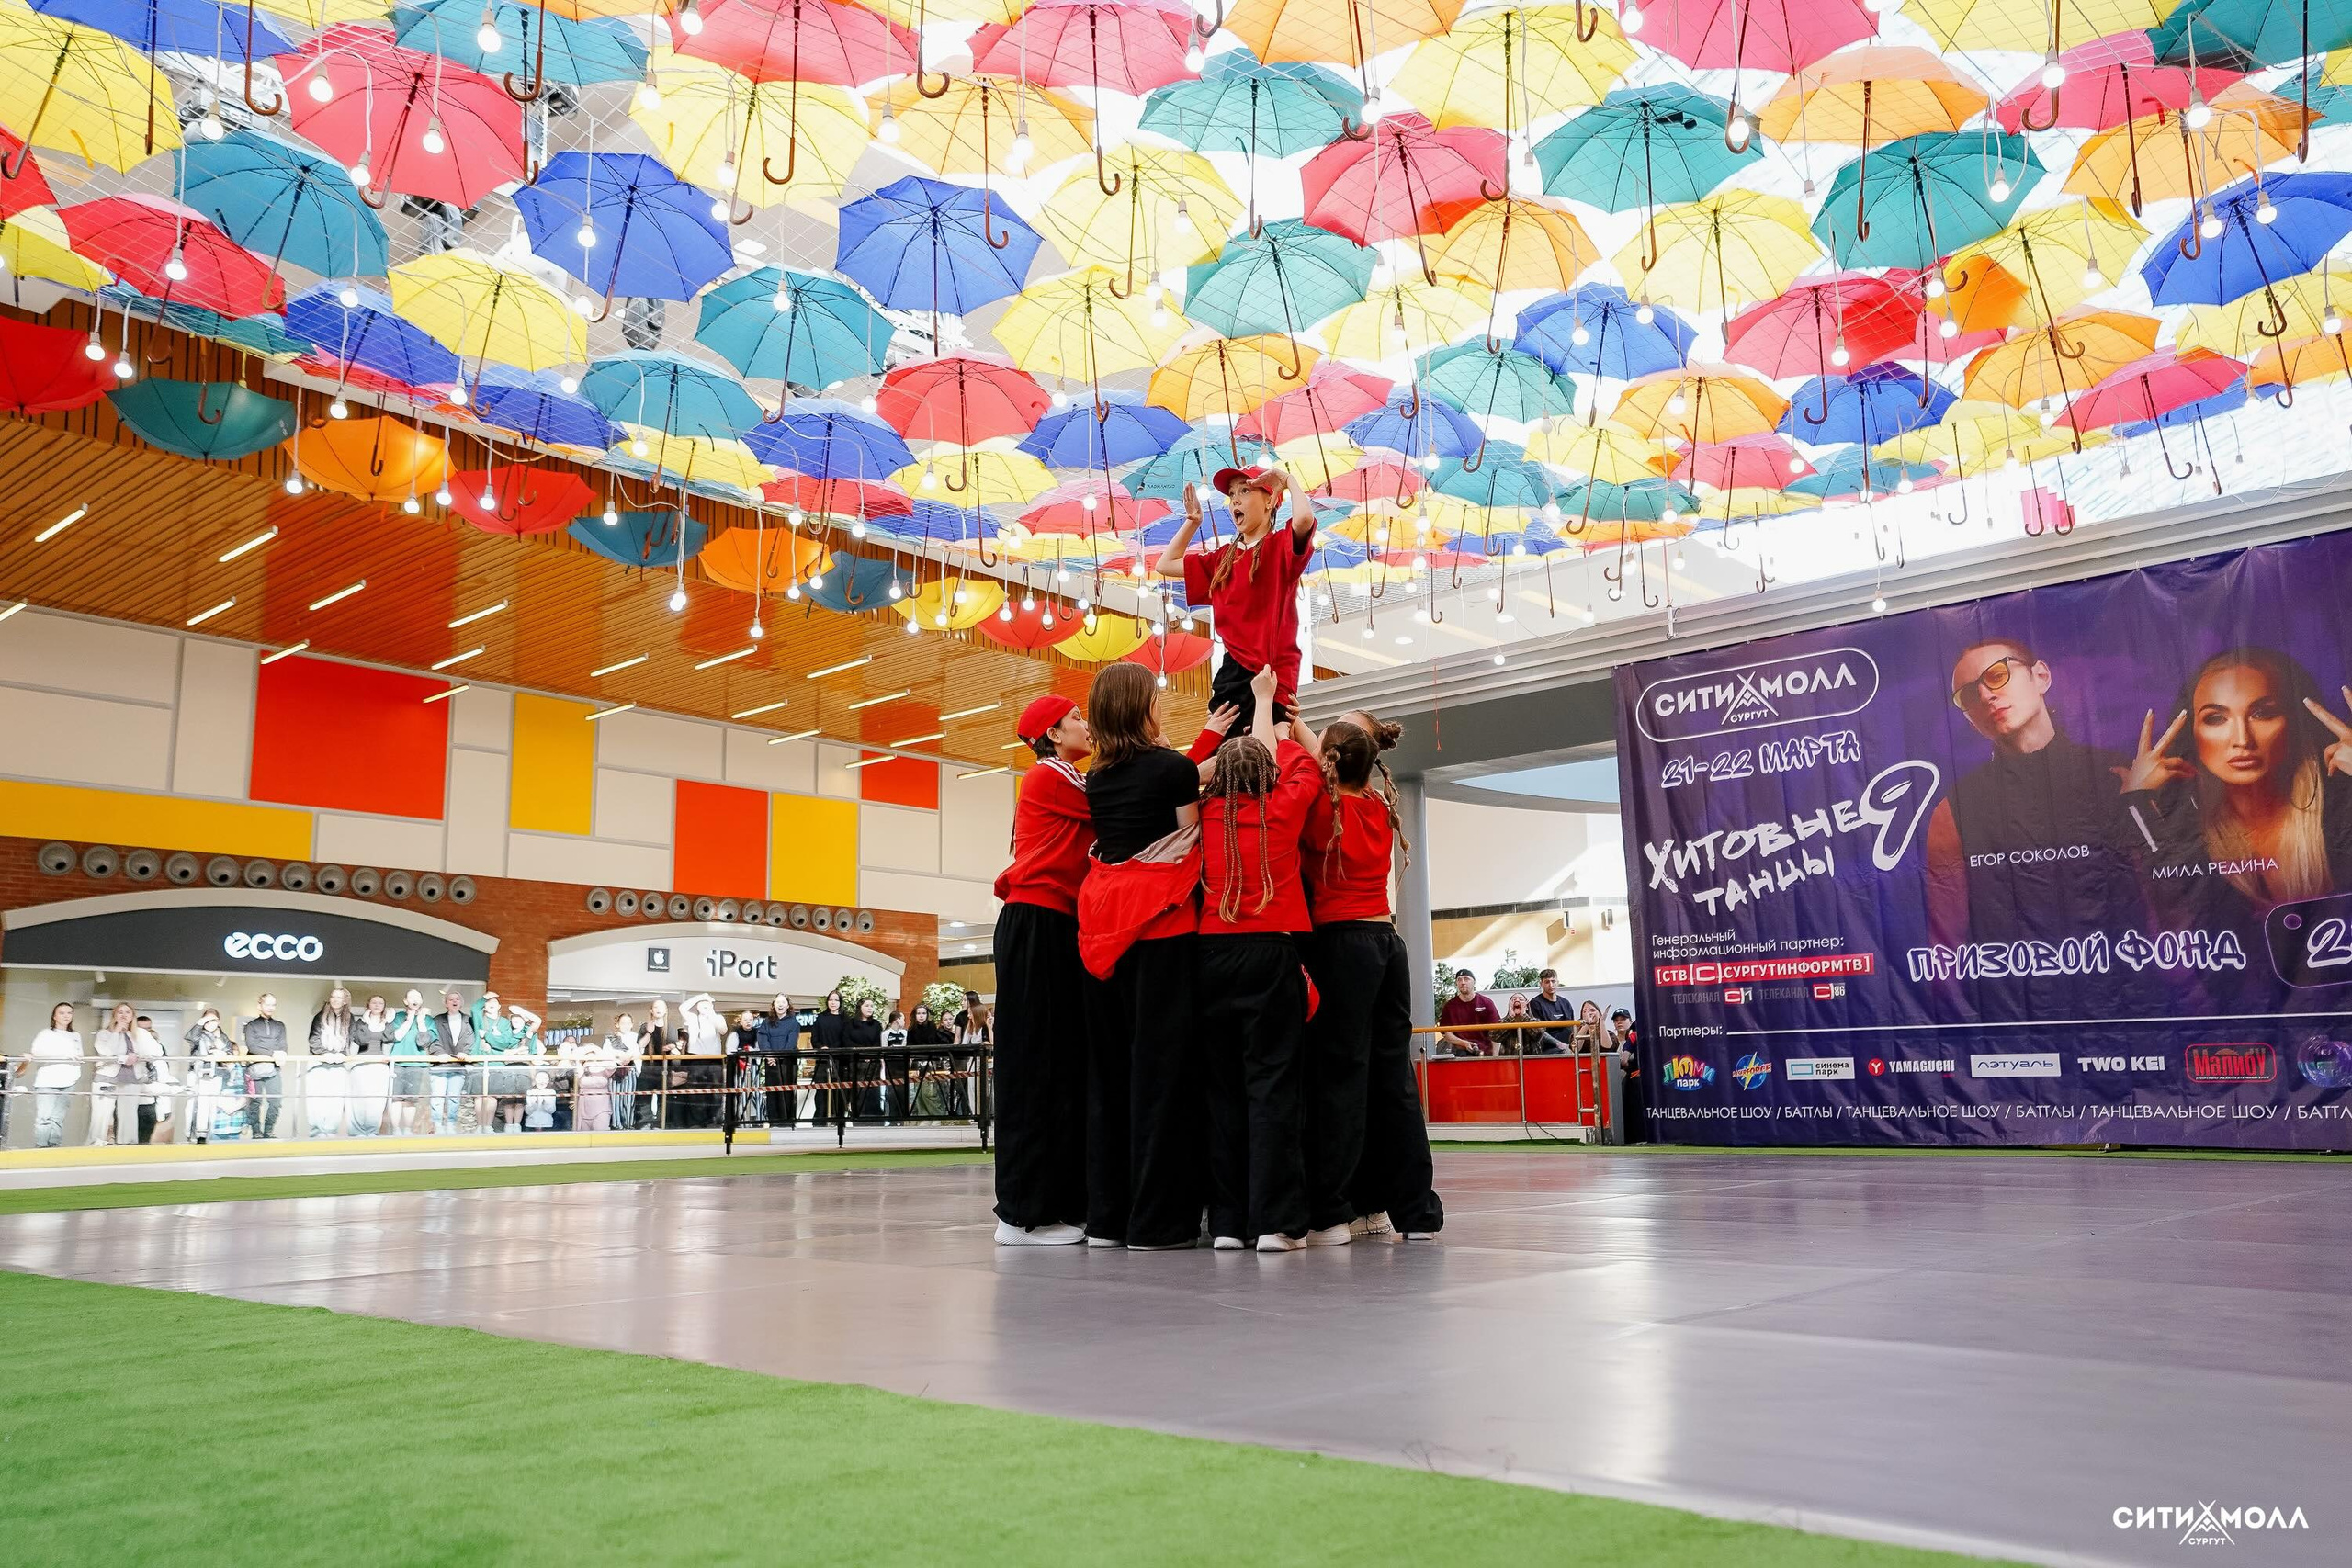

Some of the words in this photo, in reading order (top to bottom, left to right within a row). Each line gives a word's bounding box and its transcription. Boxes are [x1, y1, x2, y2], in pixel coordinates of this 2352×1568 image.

[1655, 682, 1734, 716] СИТИ
[1759, 663, 1857, 699] МОЛЛ
[1729, 709, 1770, 724] СУРГУТ
[1660, 750, 1754, 788] 21-22
[1758, 730, 1861, 774] МАРТА
[1644, 799, 1863, 893] ХИТОВЫЕ
[1969, 852, 2006, 868] ЕГОР
[2009, 844, 2090, 864] СОКОЛОВ
[2152, 863, 2203, 880] МИЛА
[2207, 857, 2279, 875] РЕДИНА
[1693, 845, 1836, 917] ТАНЦЫ
[224, 931, 324, 962] ecco
[1652, 929, 1736, 946] Генеральный
[1652, 940, 1777, 960] информационный
[1780, 935, 1846, 953] партнер:
[2306, 918, 2352, 969] 2
[707, 949, 778, 980] iPort
[1906, 931, 2109, 983] ПРИЗОВОЙ
[2114, 929, 2246, 972] ФОНД
[1672, 991, 1720, 1005] ТЕЛЕКАНАЛ
[1758, 987, 1809, 1000] ТЕЛЕКАНАЛ
[1658, 1025, 1723, 1039] Партнеры:
[1815, 1068, 1839, 1077] парк
[1889, 1059, 1956, 1073] YAMAGUCHI
[2077, 1057, 2127, 1072] TWO
[2130, 1056, 2166, 1071] KEI
[1676, 1077, 1700, 1089] парк
[1645, 1106, 1738, 1120] ТАНЦЕВАЛЬНОЕ
[1740, 1106, 1772, 1119] ШОУ
[1784, 1106, 1833, 1119] БАТТЛЫ
[1846, 1105, 1958, 1120] ТАНЦЕВАЛЬНОЕ
[1962, 1105, 2001, 1118] ШОУ
[2016, 1105, 2075, 1119] БАТТЛЫ
[2089, 1105, 2226, 1120] ТАНЦЕВАЛЬНОЕ
[2231, 1105, 2278, 1119] ШОУ
